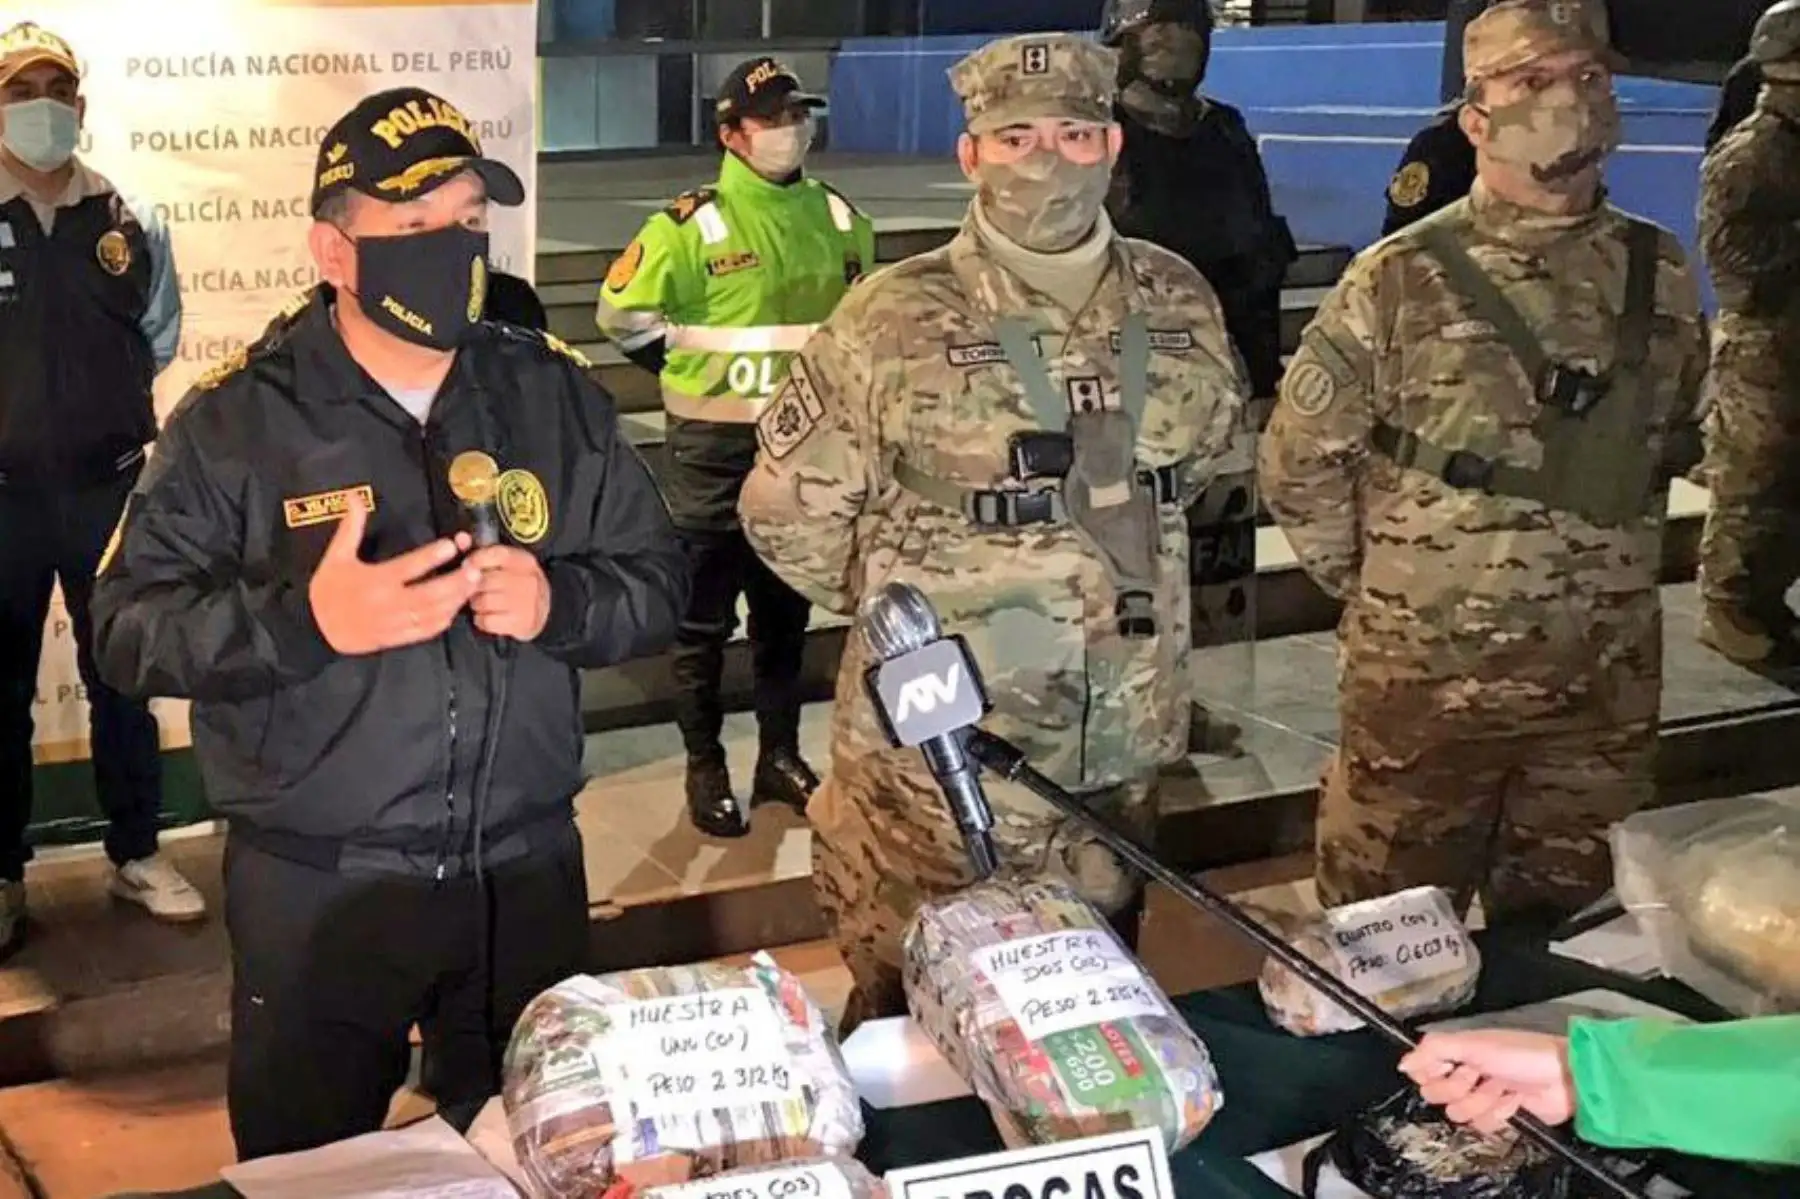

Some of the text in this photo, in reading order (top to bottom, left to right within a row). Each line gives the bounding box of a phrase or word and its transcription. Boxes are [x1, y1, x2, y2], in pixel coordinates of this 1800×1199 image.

[126, 44, 512, 78] POLICÍA NACIONAL DEL PERÚ
[130, 124, 329, 152] POLICÍA NACIO
[155, 195, 312, 223] OLICÍA NACI
[178, 266, 316, 293] LICÍA NACI
[381, 294, 433, 336] POLICIA
[181, 335, 245, 362] LICÍ
[989, 935, 1101, 972] MUESTRA
[1021, 958, 1064, 984] DOS
[630, 995, 749, 1029] MUESTRA
[646, 1072, 696, 1098] PESO
